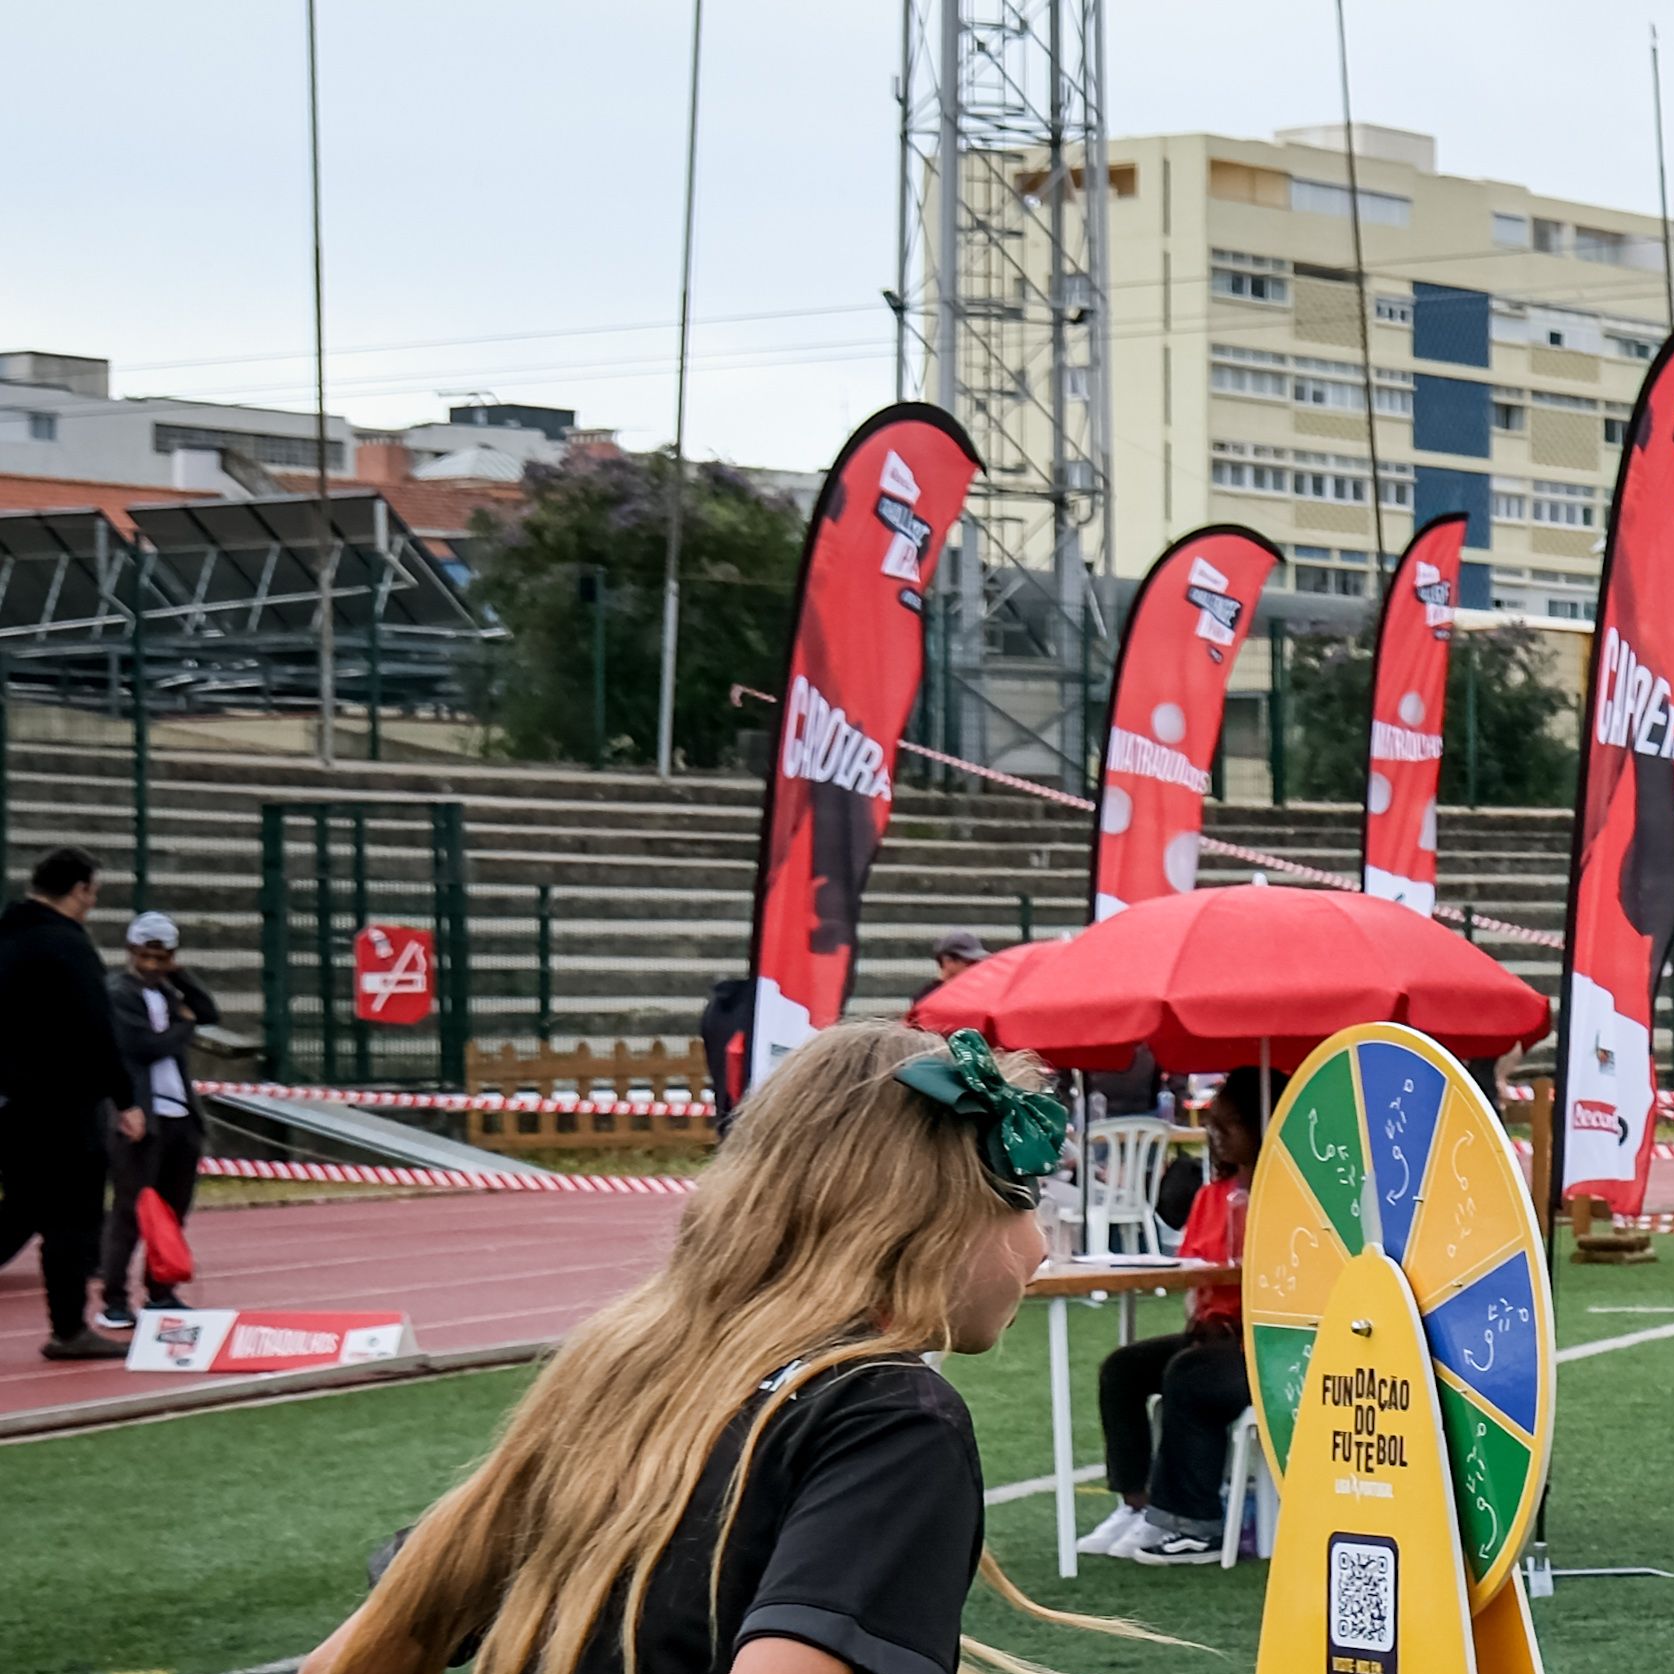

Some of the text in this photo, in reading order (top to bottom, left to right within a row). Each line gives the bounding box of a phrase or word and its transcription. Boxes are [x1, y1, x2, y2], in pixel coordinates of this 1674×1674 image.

[1322, 1367, 1410, 1412] FUNDAÇÃO
[1354, 1404, 1376, 1437] DO
[1331, 1430, 1409, 1474] FUTEBOL
